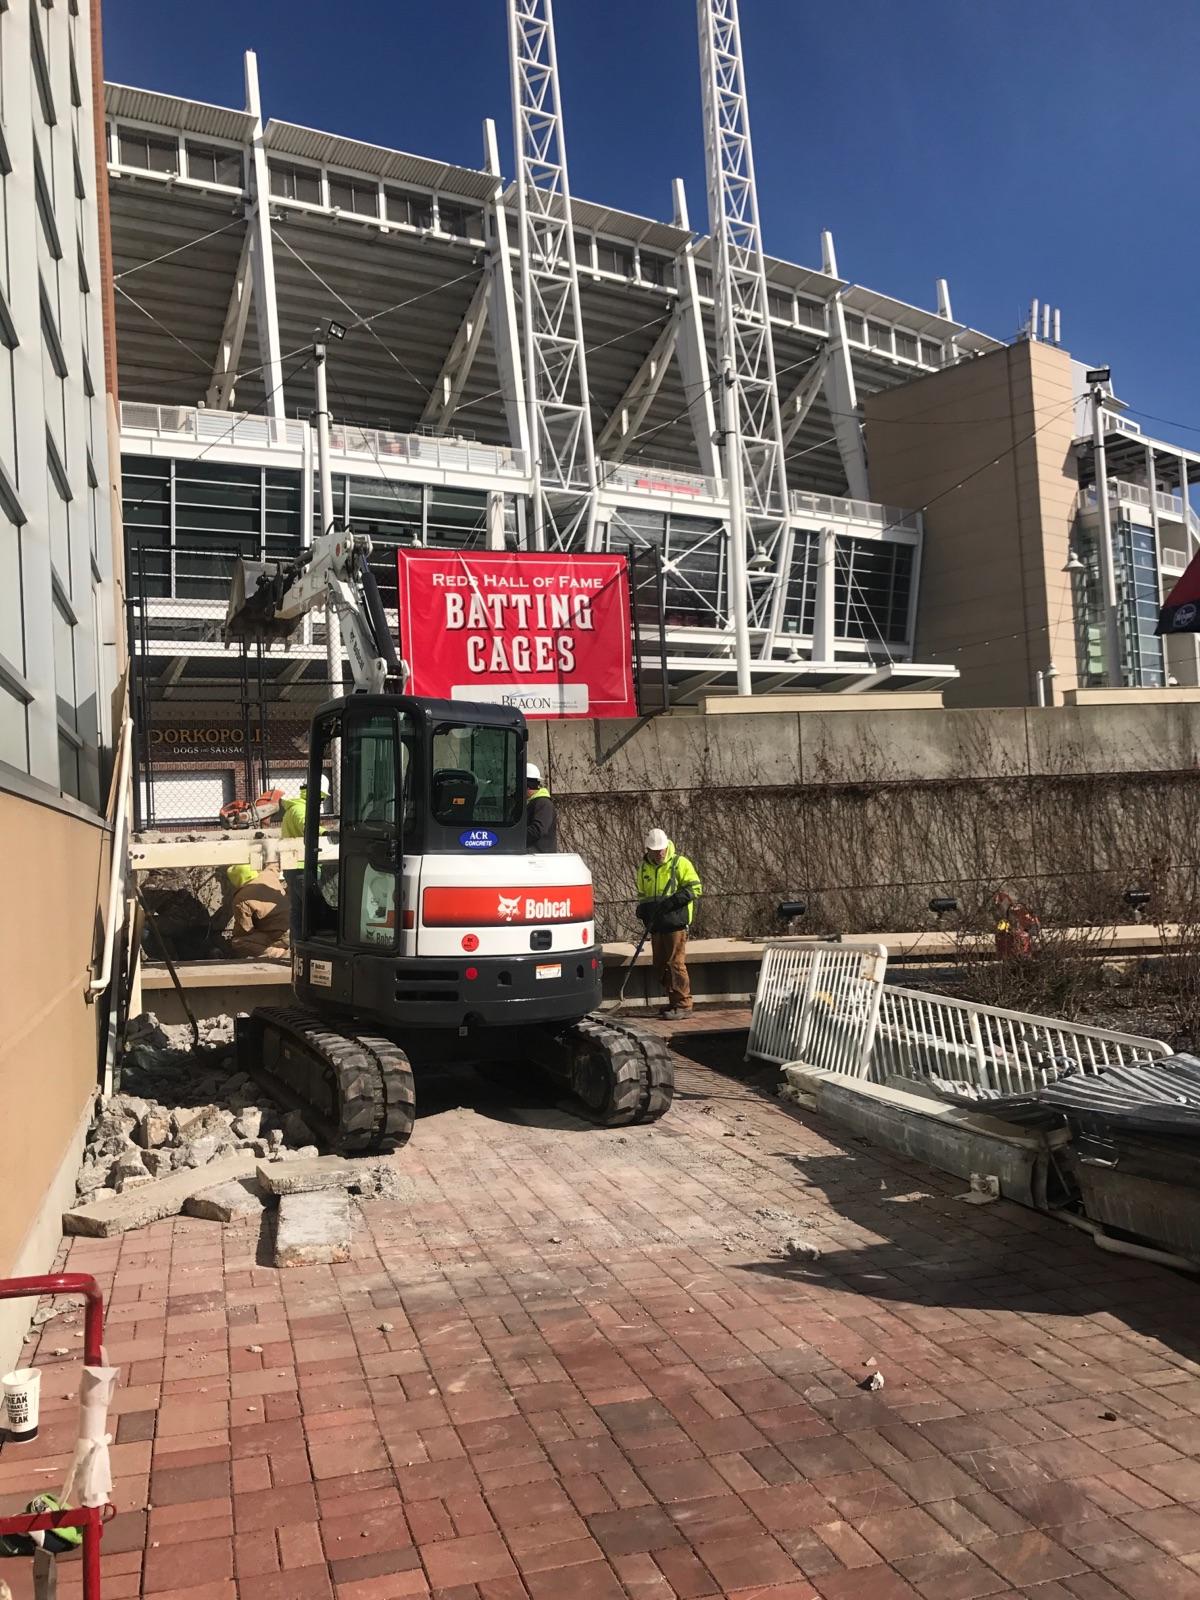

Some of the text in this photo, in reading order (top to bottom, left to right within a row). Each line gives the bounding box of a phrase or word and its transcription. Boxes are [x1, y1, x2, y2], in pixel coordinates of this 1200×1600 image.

[432, 573, 604, 589] REDS HALL OF FAME
[445, 592, 594, 630] BATTING
[466, 635, 577, 673] CAGES
[501, 694, 551, 709] BEACON
[149, 729, 272, 743] DORKOPOI
[469, 831, 488, 840] ACR
[524, 897, 573, 919] Bobcat
